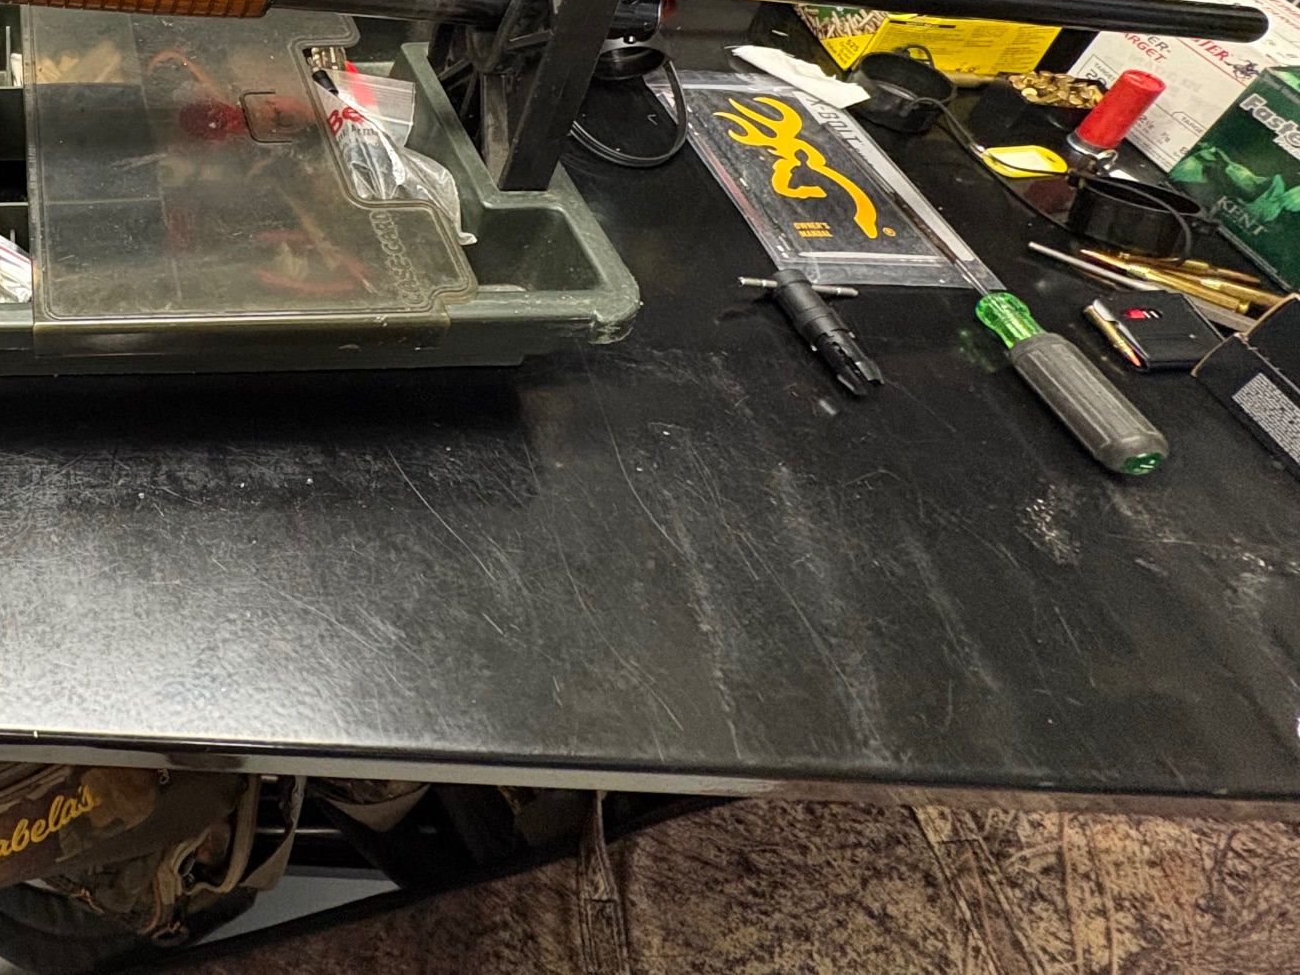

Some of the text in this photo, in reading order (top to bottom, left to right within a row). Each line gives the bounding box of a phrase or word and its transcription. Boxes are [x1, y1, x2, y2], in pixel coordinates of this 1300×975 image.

[845, 38, 860, 53] 525
[805, 97, 863, 147] X-BOLT
[793, 222, 831, 230] OWNER'S
[799, 230, 833, 238] MANUAL
